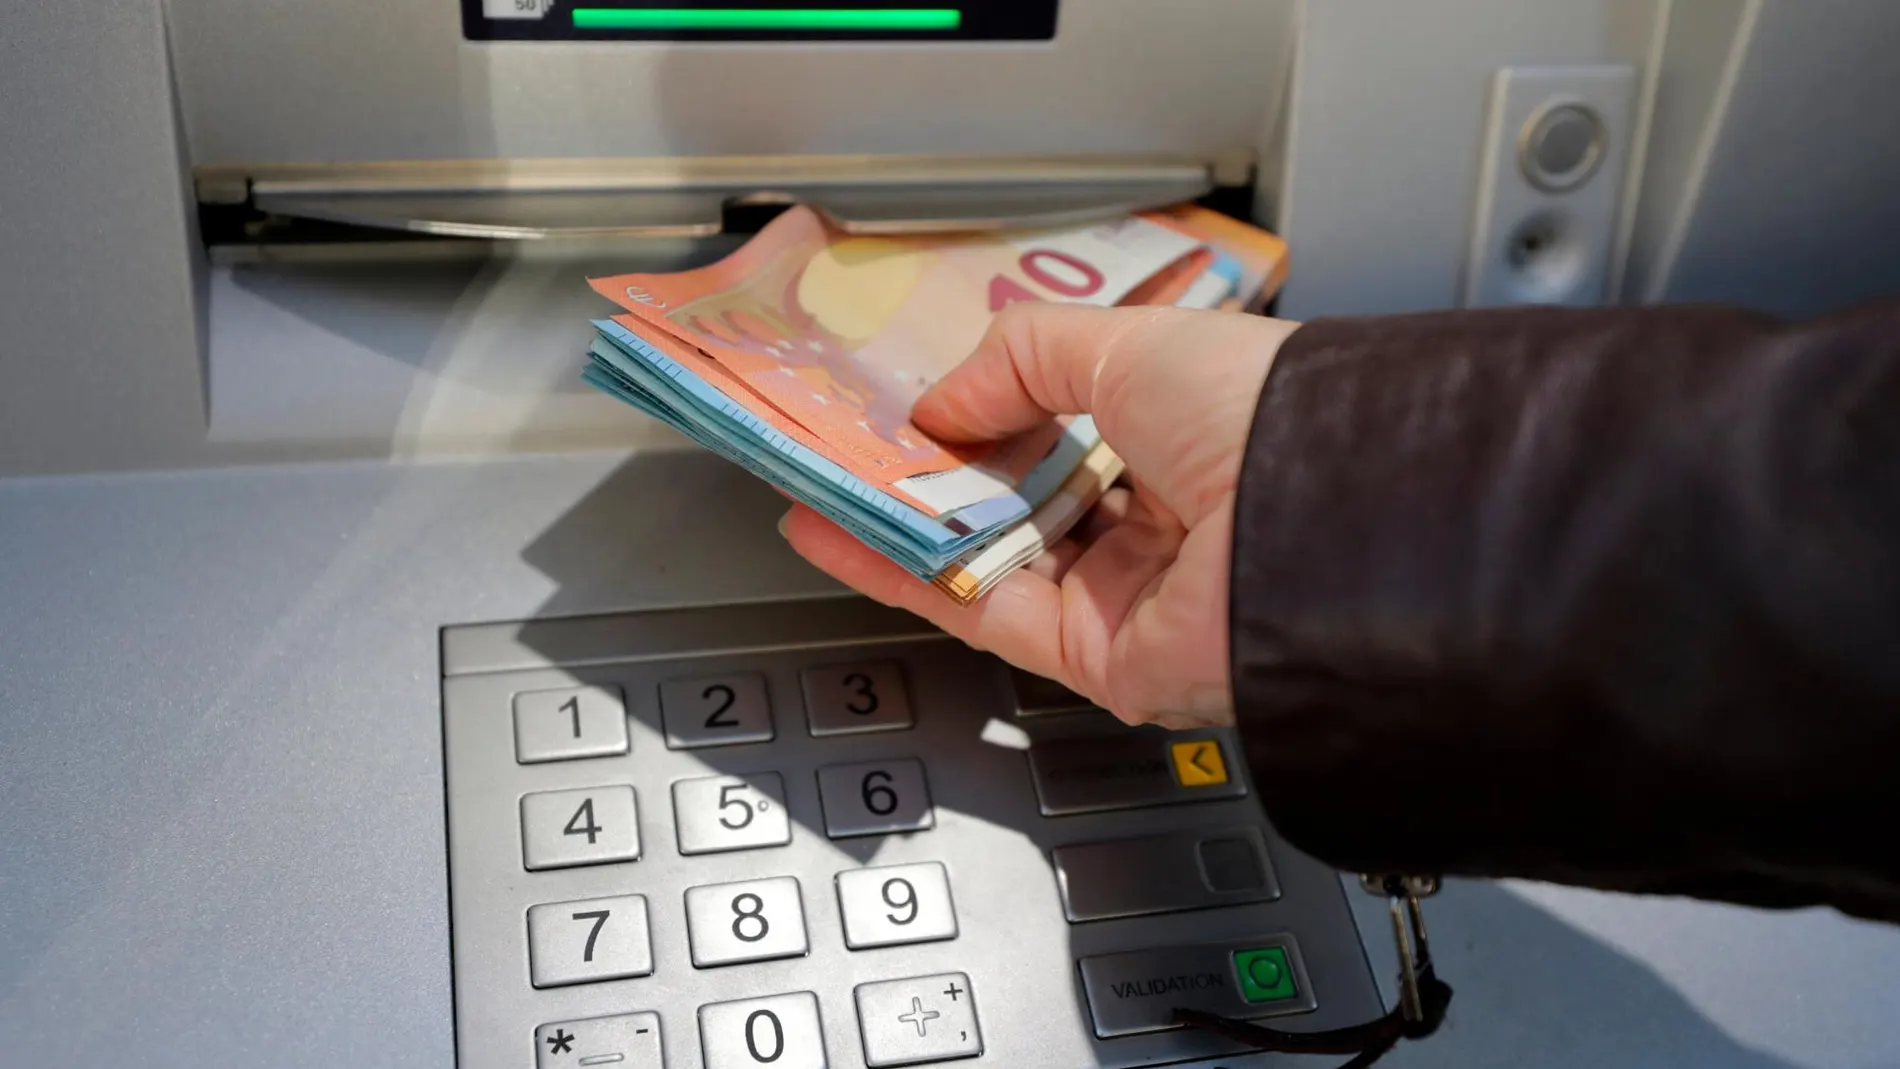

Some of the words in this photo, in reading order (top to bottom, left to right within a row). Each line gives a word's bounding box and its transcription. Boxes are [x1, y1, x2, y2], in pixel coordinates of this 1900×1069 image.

[558, 695, 582, 739] 1
[702, 684, 740, 729] 2
[842, 673, 880, 716] 3
[563, 797, 603, 845] 4
[717, 783, 756, 830] 5
[860, 770, 899, 816] 6
[571, 909, 611, 963] 7
[730, 892, 770, 943] 8
[881, 877, 919, 926] 9
[1110, 971, 1224, 999] VALIDATION
[744, 1008, 785, 1064] 0
